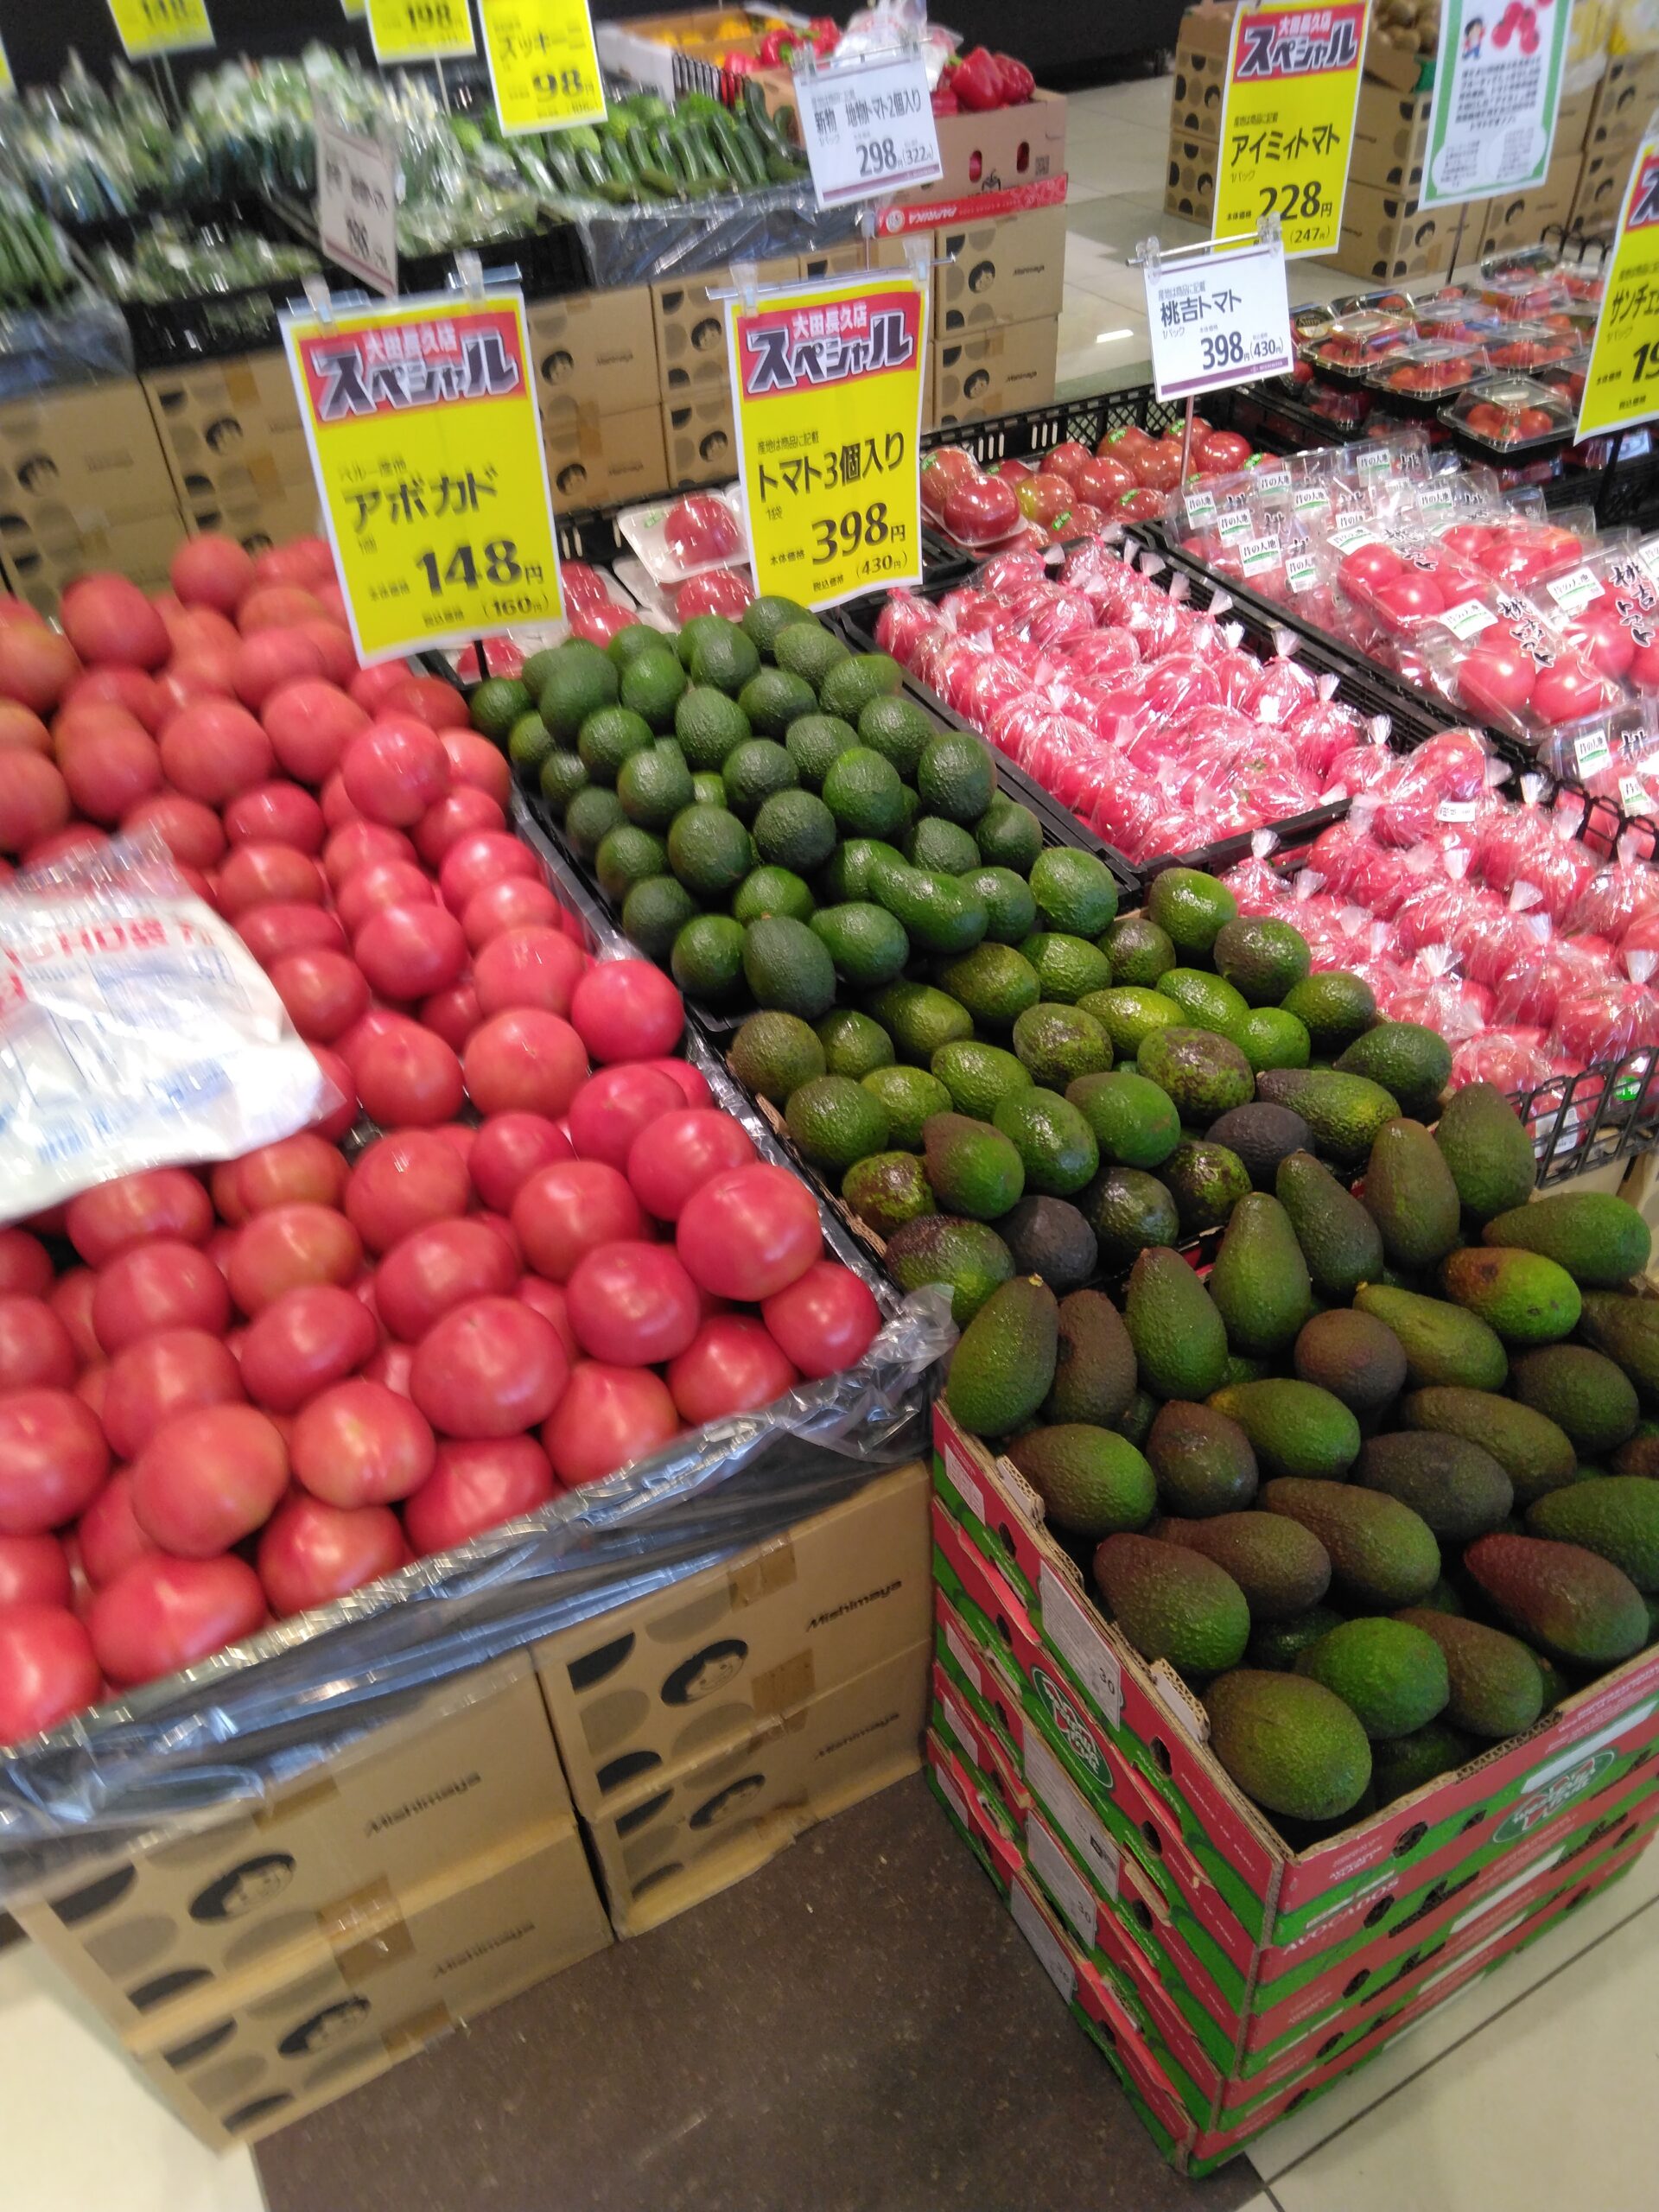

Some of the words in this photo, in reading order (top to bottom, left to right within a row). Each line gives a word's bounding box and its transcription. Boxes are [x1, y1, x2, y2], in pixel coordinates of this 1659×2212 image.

[1237, 18, 1357, 77] スペシャル
[1231, 123, 1340, 168] アイミィトマト
[793, 302, 868, 340] 大田長久店
[1160, 289, 1242, 327] 桃吉トマト
[310, 328, 518, 422] スペシャル
[747, 311, 913, 394] スペシャル
[758, 430, 820, 454] 産地は商品に記載
[759, 431, 905, 503] トマト3個入り
[342, 464, 499, 534] アボカド
[770, 550, 805, 566] 本体価格
[813, 574, 844, 593] 税込価格
[805, 1580, 903, 1633] Mishimaya
[1099, 1668, 1116, 1695] 30
[815, 1712, 899, 1761] Mishimaya
[365, 1771, 481, 1838] Mishimaya
